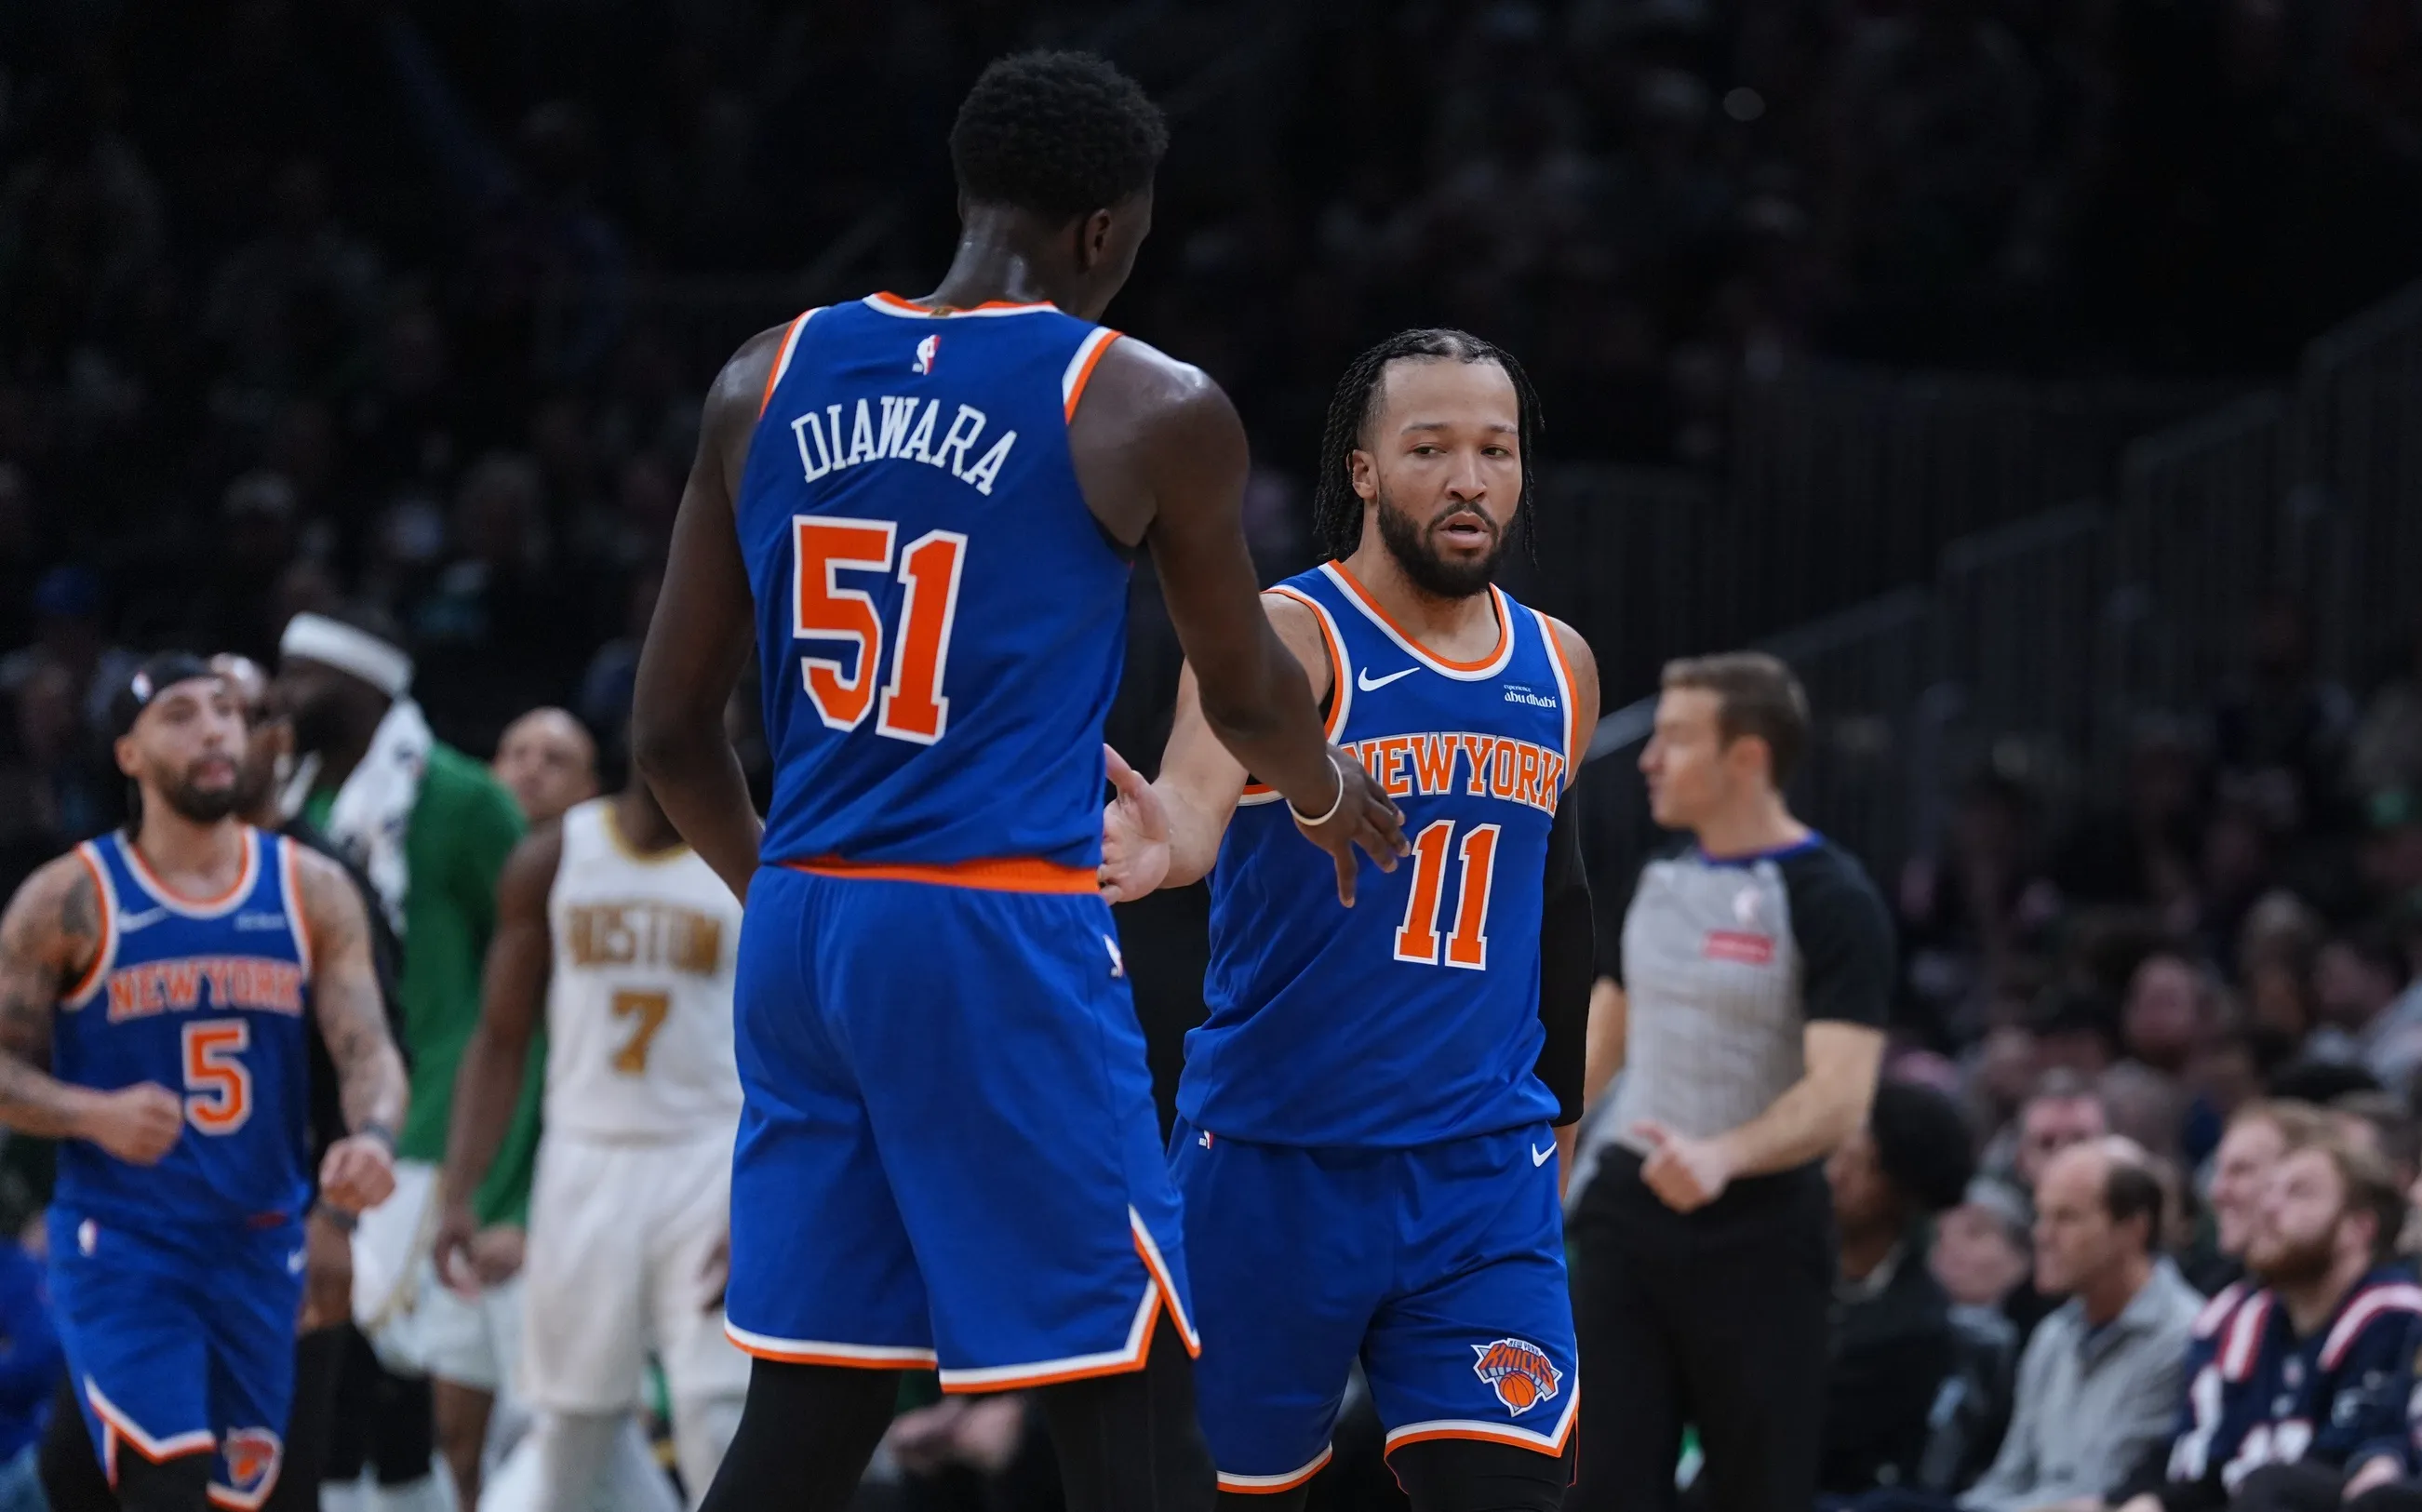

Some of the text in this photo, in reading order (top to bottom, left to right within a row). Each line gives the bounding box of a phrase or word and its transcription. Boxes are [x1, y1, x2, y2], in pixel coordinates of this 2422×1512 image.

[791, 395, 1017, 496] DIAWARA
[793, 515, 968, 746] 51
[1505, 691, 1557, 708] abu dhabi
[1462, 731, 1566, 819] YORK
[1394, 820, 1501, 970] 11
[107, 956, 302, 1022] NEW YORK
[611, 987, 671, 1074] 7
[181, 1018, 251, 1136] 5
[1477, 1342, 1556, 1397] KNICKS
